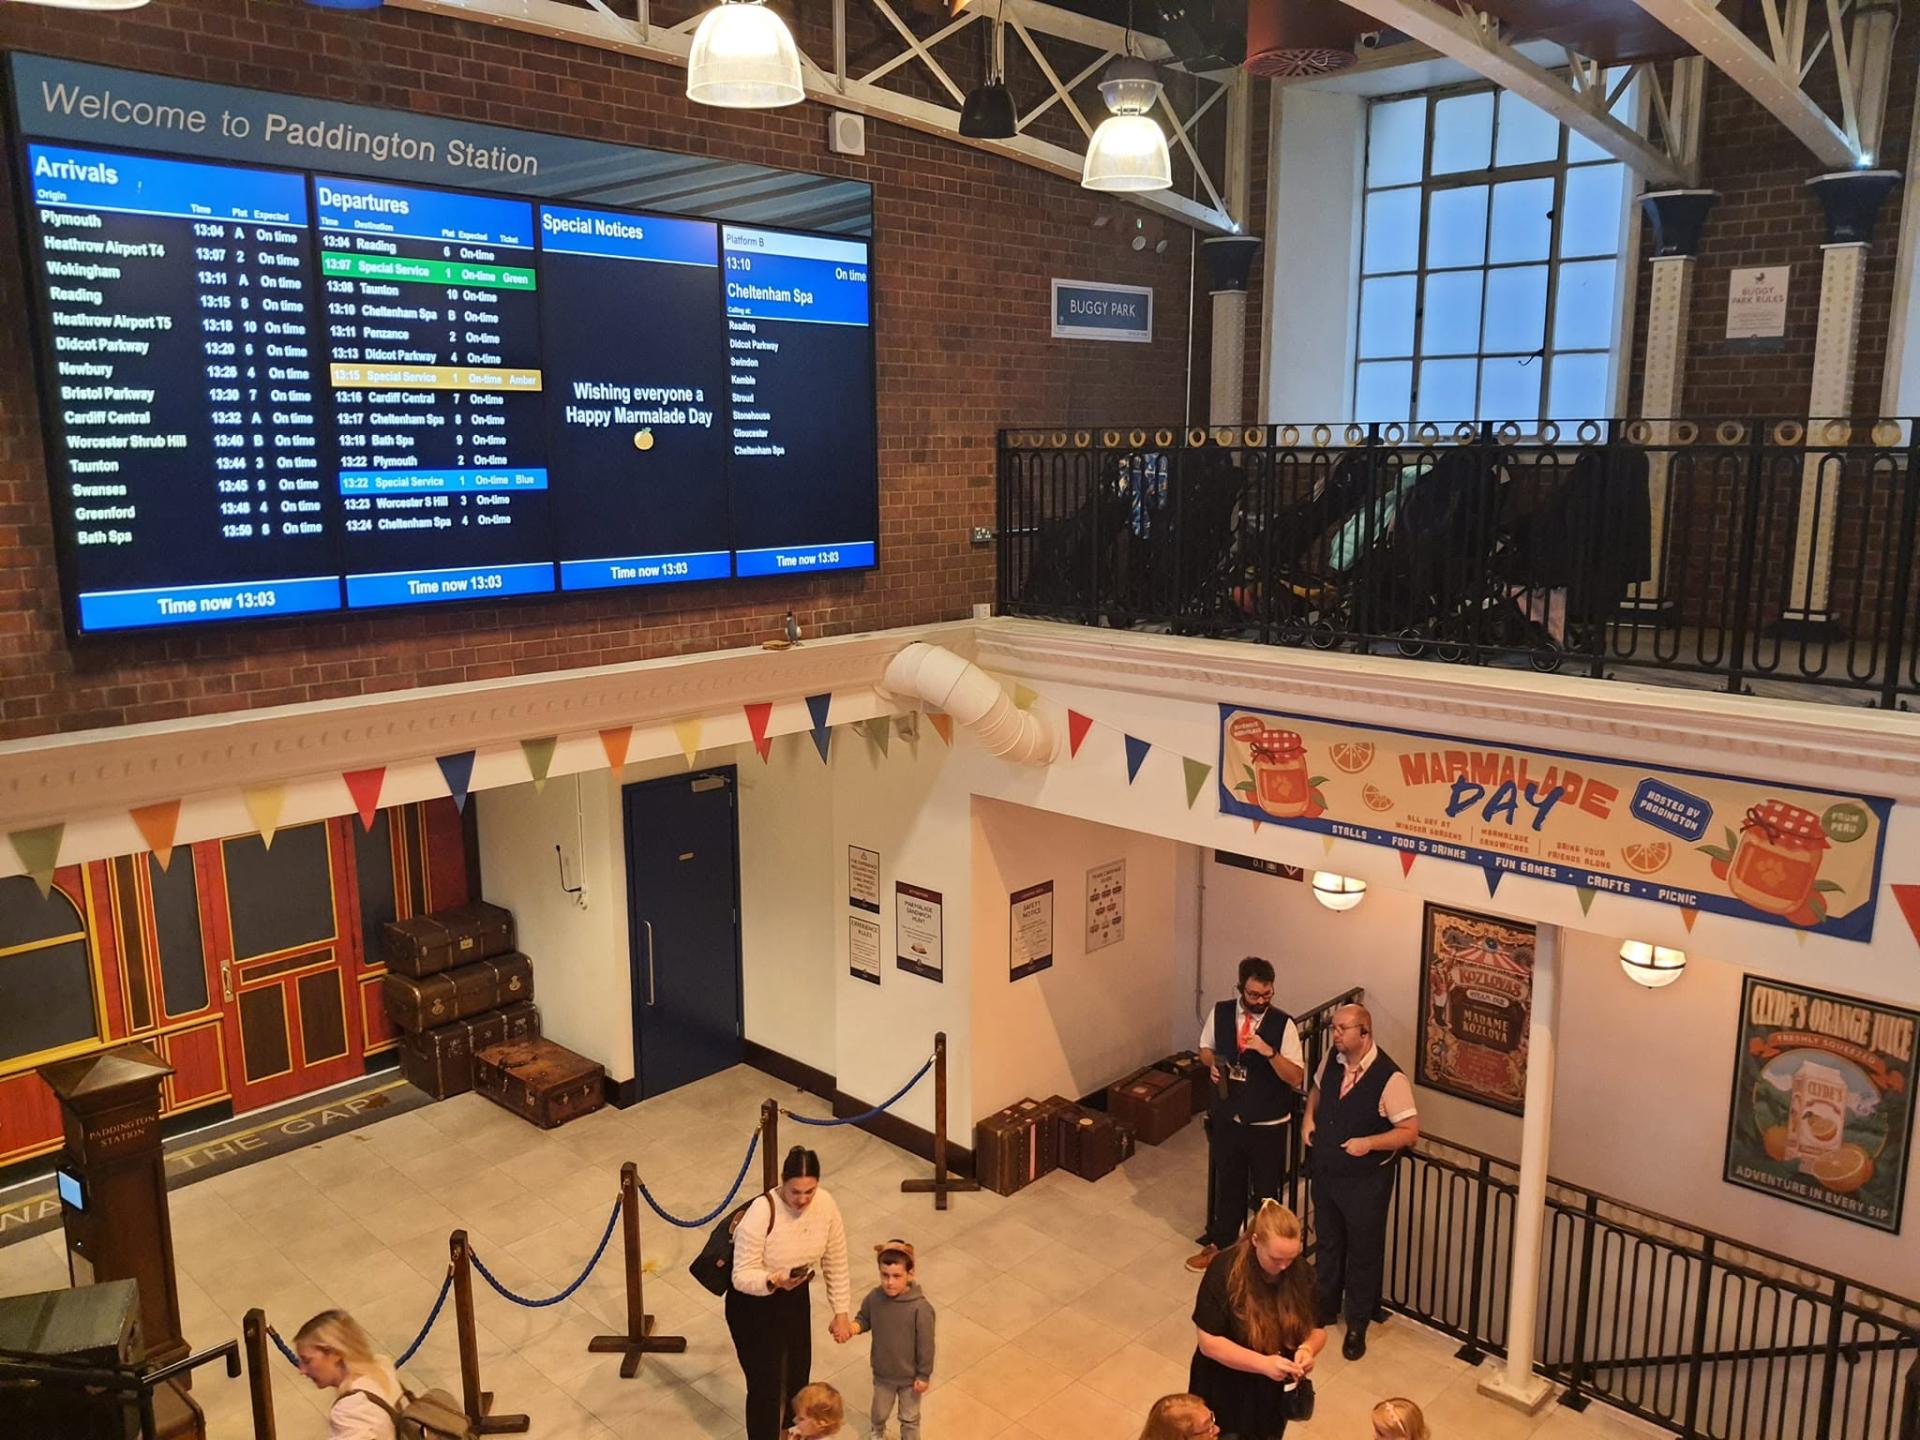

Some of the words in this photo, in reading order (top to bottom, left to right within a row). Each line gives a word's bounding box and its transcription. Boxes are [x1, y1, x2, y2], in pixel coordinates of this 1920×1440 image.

[42, 80, 206, 132] Welcome
[222, 111, 250, 138] to
[265, 114, 434, 161] Paddington
[447, 140, 538, 175] Station
[35, 156, 118, 184] Arrivals
[37, 189, 67, 201] Origin
[319, 187, 409, 214] Departures
[40, 210, 101, 228] Plymouth
[194, 224, 224, 237] 13:04
[257, 229, 271, 242] On
[272, 230, 298, 243] time
[354, 220, 393, 232] Destination
[543, 213, 592, 235] Special
[595, 219, 643, 240] Notices
[323, 236, 350, 248] 13:04
[356, 238, 396, 254] Reading
[726, 233, 756, 247] Platform
[759, 237, 764, 247] B
[44, 236, 104, 253] Heathrow
[106, 241, 147, 257] Airport
[149, 244, 164, 257] T4
[196, 248, 226, 261] 13:07
[47, 261, 120, 280] Wokingham
[198, 272, 227, 285] 13:11
[358, 260, 393, 274] Special
[395, 263, 429, 277] Service
[461, 270, 495, 282] On-time
[503, 273, 528, 284] Green
[726, 257, 750, 271] 13:10
[835, 267, 848, 280] On
[849, 269, 867, 282] time
[50, 286, 102, 304] Reading
[201, 295, 230, 308] 13:15
[360, 283, 399, 295] Taunton
[727, 283, 791, 302] Cheltenham
[793, 289, 813, 305] Spa
[362, 305, 417, 319] Cheltenham
[419, 308, 437, 321] Spa
[1070, 299, 1108, 315] BUGGY
[1111, 302, 1136, 318] PARK
[53, 312, 111, 328] Heathrow
[114, 315, 154, 331] Airport
[157, 317, 172, 330] T5
[729, 321, 756, 333] Reading
[330, 326, 355, 337] 13:11
[363, 327, 409, 340] Penzance
[56, 337, 97, 351] Didcot
[100, 340, 149, 355] Parkway
[729, 339, 750, 350] Didcot
[752, 339, 778, 352] Parkway
[365, 348, 396, 360] Didcot
[398, 350, 436, 364] Parkway
[730, 357, 758, 367] Swindon
[59, 362, 113, 378] Newbury
[367, 370, 402, 383] Special
[404, 371, 436, 382] Service
[510, 375, 536, 385] Amber
[731, 375, 756, 385] Kemble
[62, 387, 102, 400] Bristol
[104, 388, 154, 402] Parkway
[368, 392, 400, 403] Cardiff
[402, 392, 435, 404] Central
[574, 382, 630, 403] Wishing
[633, 388, 693, 406] everyone
[696, 390, 704, 401] a
[732, 393, 754, 403] Stroud
[64, 411, 106, 424] Cardiff
[108, 412, 150, 424] Central
[370, 413, 425, 424] Cheltenham
[427, 415, 444, 427] Spa
[566, 406, 611, 427] Happy
[614, 407, 686, 424] Marmalade
[689, 409, 712, 428] Day
[732, 411, 770, 420] Stonehouse
[734, 428, 768, 438] Gloucester
[67, 435, 128, 448] Worcester
[130, 435, 165, 448] Shrub
[168, 435, 187, 448] Hill
[372, 435, 394, 446] Bath
[396, 436, 414, 448] Spa
[734, 445, 770, 456] Cheltenham
[772, 446, 785, 457] Spa
[70, 459, 119, 472] Taunton
[373, 456, 417, 469] Plymouth
[72, 484, 127, 496] Swansea
[375, 477, 409, 489] Special
[411, 477, 444, 486] Service
[516, 475, 534, 484] Blue
[377, 498, 423, 509] Worcester
[433, 496, 448, 507] Hill
[76, 506, 136, 520] Greenford
[378, 518, 432, 529] Cheltenham
[434, 517, 451, 528] Spa
[78, 531, 106, 544] Bath
[109, 531, 132, 545] Spa
[776, 555, 797, 567] Time
[799, 554, 816, 566] now
[818, 551, 839, 563] 13:03
[610, 566, 636, 580] Time
[638, 566, 659, 577] now
[662, 562, 688, 576] 13:03
[408, 579, 438, 595] Time
[442, 578, 467, 591] now
[470, 575, 502, 589] 13:03
[158, 598, 197, 616] Time
[200, 596, 232, 611] now
[236, 591, 275, 609] 13:03
[1399, 750, 1619, 820] MARMALADE
[1446, 774, 1564, 831] DAY
[1647, 790, 1685, 814] HOSTED
[1686, 807, 1701, 818] BY
[1639, 800, 1698, 831] PADDINGTON
[1831, 811, 1860, 824] FROM
[1830, 821, 1857, 834] PERU
[1331, 823, 1367, 840] STALLS
[1392, 836, 1415, 849] FOOD
[1418, 841, 1427, 851] &
[1432, 845, 1466, 859] DRINKS
[1495, 856, 1517, 870] FUN
[1520, 861, 1557, 879] GAMES
[1586, 875, 1631, 893] CRAFTS
[1658, 888, 1697, 906] PICNIC
[1464, 1009, 1509, 1032] MADAME
[1808, 998, 1871, 1045] ORANGE
[1871, 1013, 1915, 1062] JUICE
[1776, 1034, 1819, 1045] FRESHLY
[89, 1113, 155, 1139] PADDINGTON
[178, 1133, 270, 1168] THE
[280, 1097, 373, 1135] GAP
[101, 1127, 146, 1146] STATION
[1735, 1165, 1806, 1196] ADVENTURE
[1810, 1185, 1822, 1199] IN
[1825, 1190, 1864, 1213] EVERY
[1868, 1204, 1889, 1220] SIP
